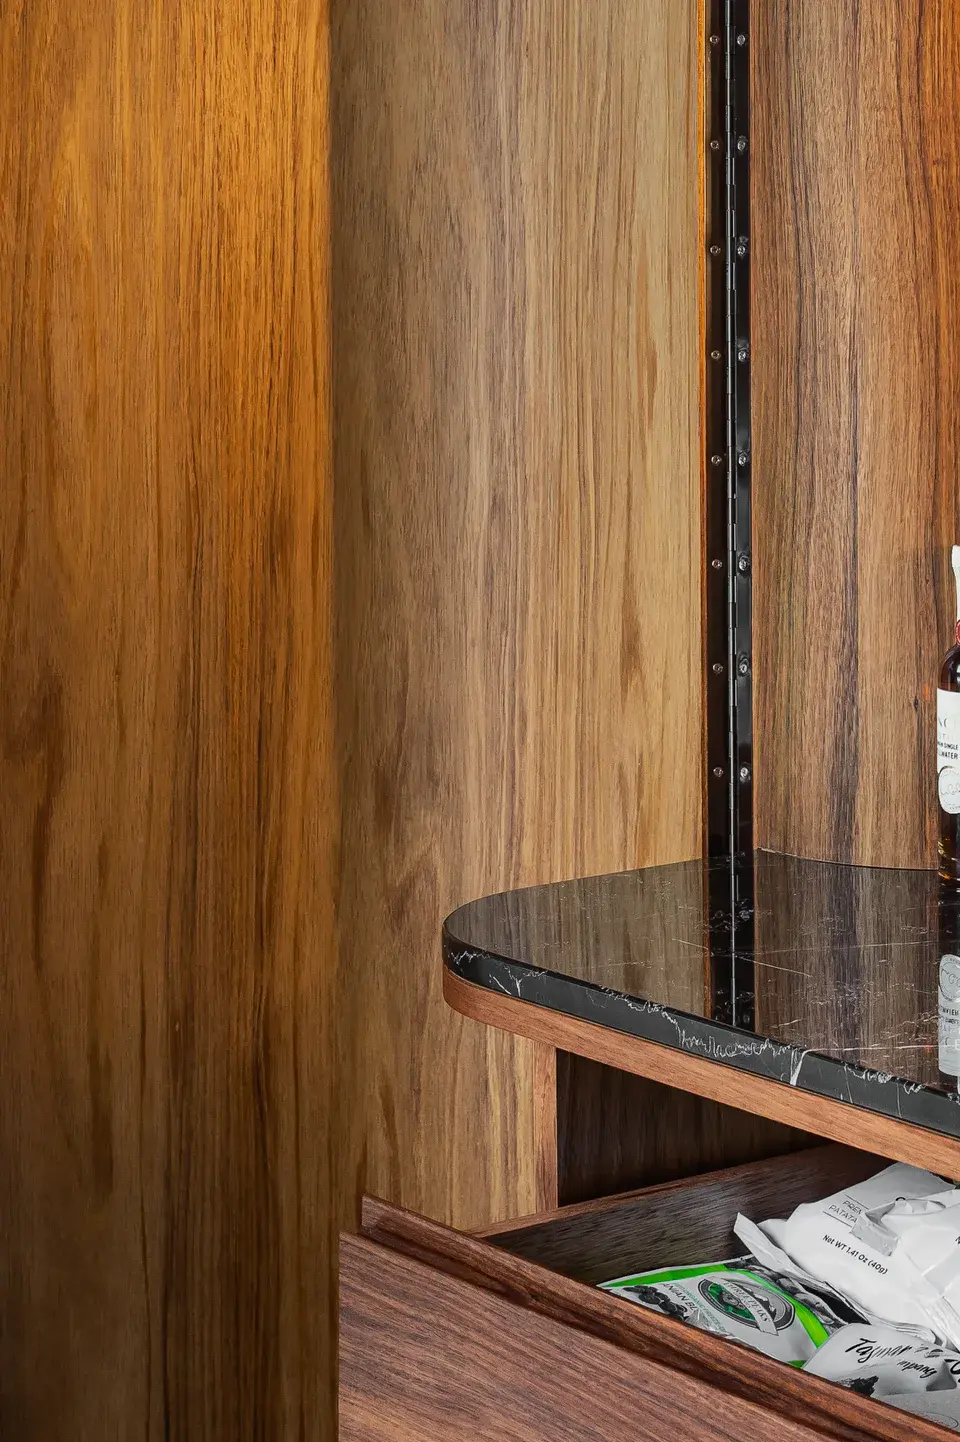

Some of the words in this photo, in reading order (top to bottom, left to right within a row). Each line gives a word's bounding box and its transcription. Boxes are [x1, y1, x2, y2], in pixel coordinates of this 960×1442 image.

[822, 1234, 835, 1245] Net
[835, 1240, 847, 1251] WT
[846, 1246, 858, 1257] 1.41
[858, 1254, 868, 1264] Oz
[867, 1259, 888, 1275] (40g)
